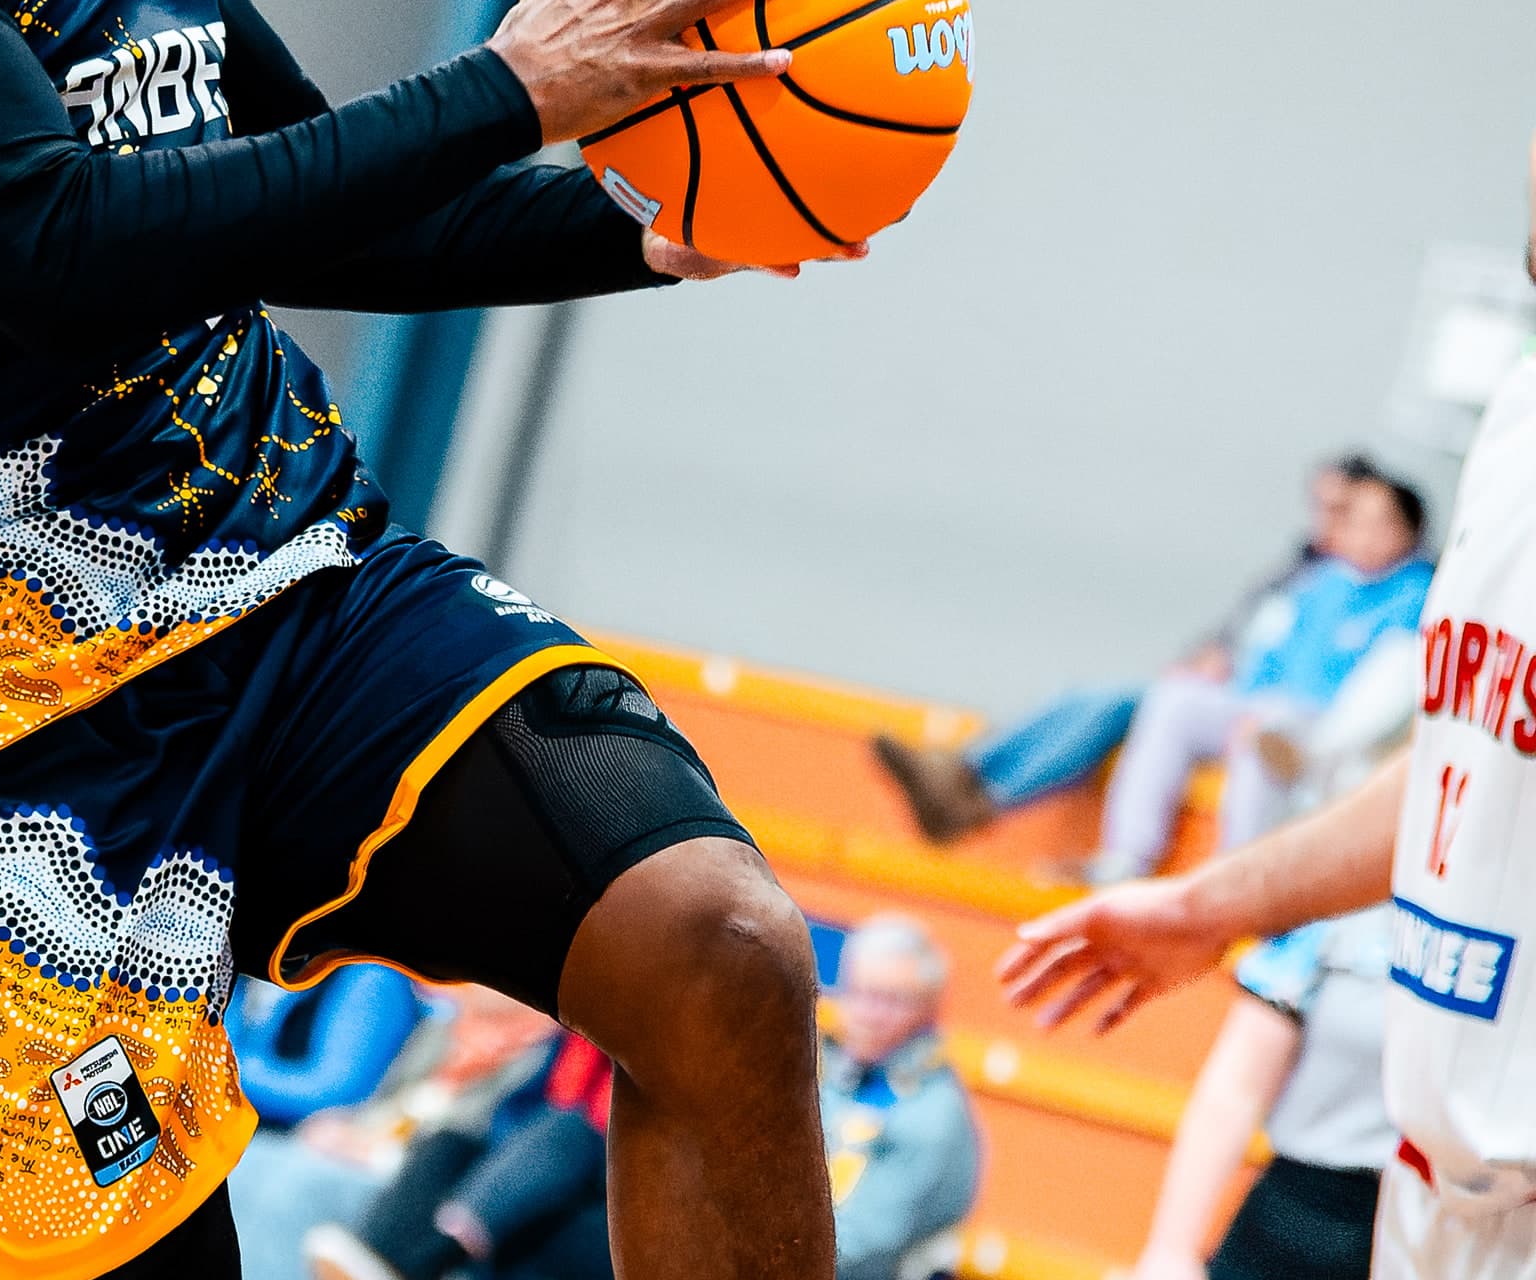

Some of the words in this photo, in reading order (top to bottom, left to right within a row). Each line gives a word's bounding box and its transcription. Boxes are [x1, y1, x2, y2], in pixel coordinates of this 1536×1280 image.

[886, 8, 976, 84] lson
[92, 1091, 122, 1118] NBL
[96, 1116, 146, 1160] ONE
[10, 1152, 37, 1176] The
[119, 1151, 141, 1171] EAST
